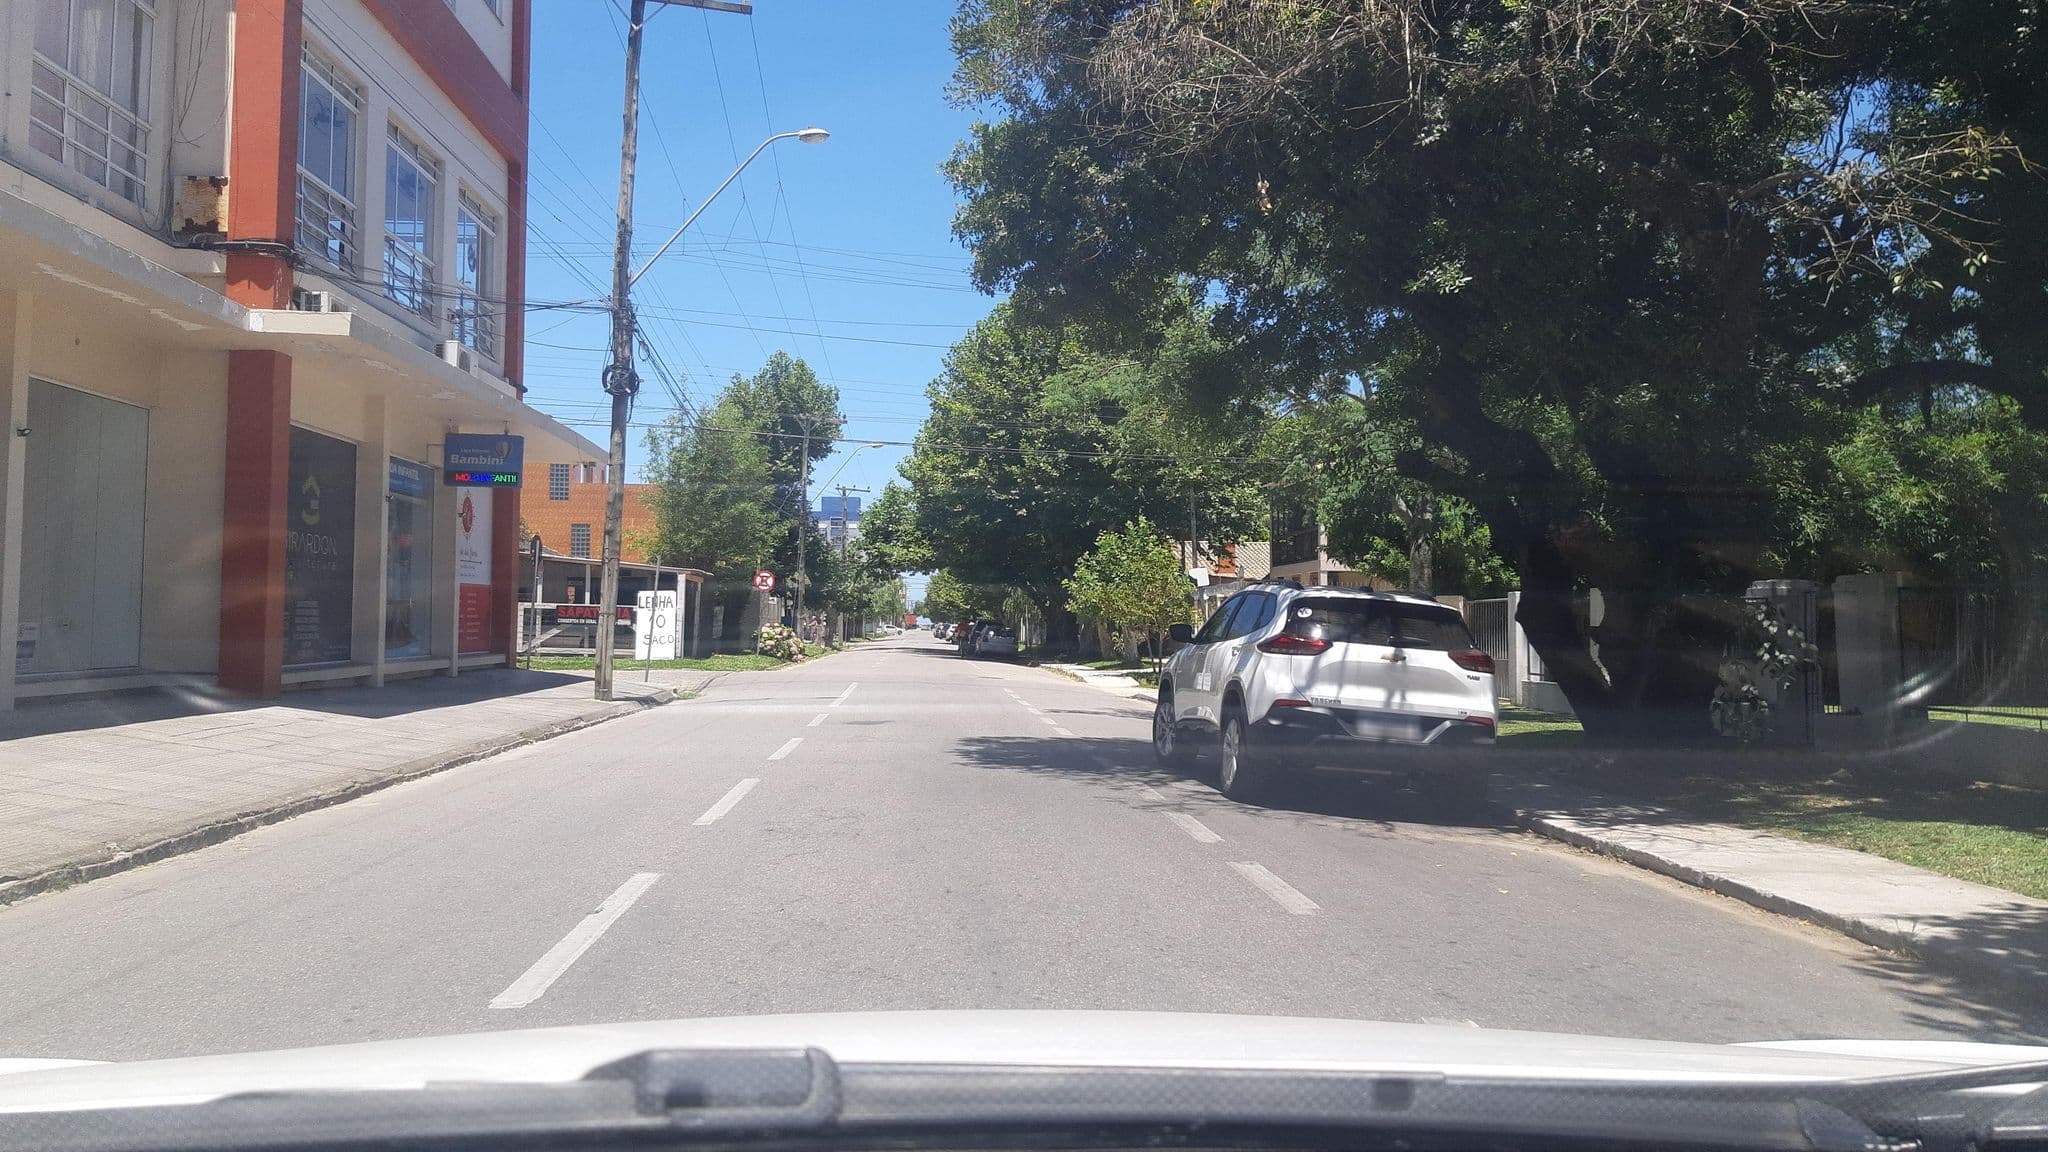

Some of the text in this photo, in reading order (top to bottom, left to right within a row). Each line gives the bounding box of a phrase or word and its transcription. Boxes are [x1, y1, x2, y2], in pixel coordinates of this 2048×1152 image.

[450, 454, 505, 465] Bambini
[288, 531, 337, 557] IRARDON
[638, 595, 674, 608] LENHA
[559, 607, 631, 619] SAPATIA
[643, 634, 675, 645] SACO
